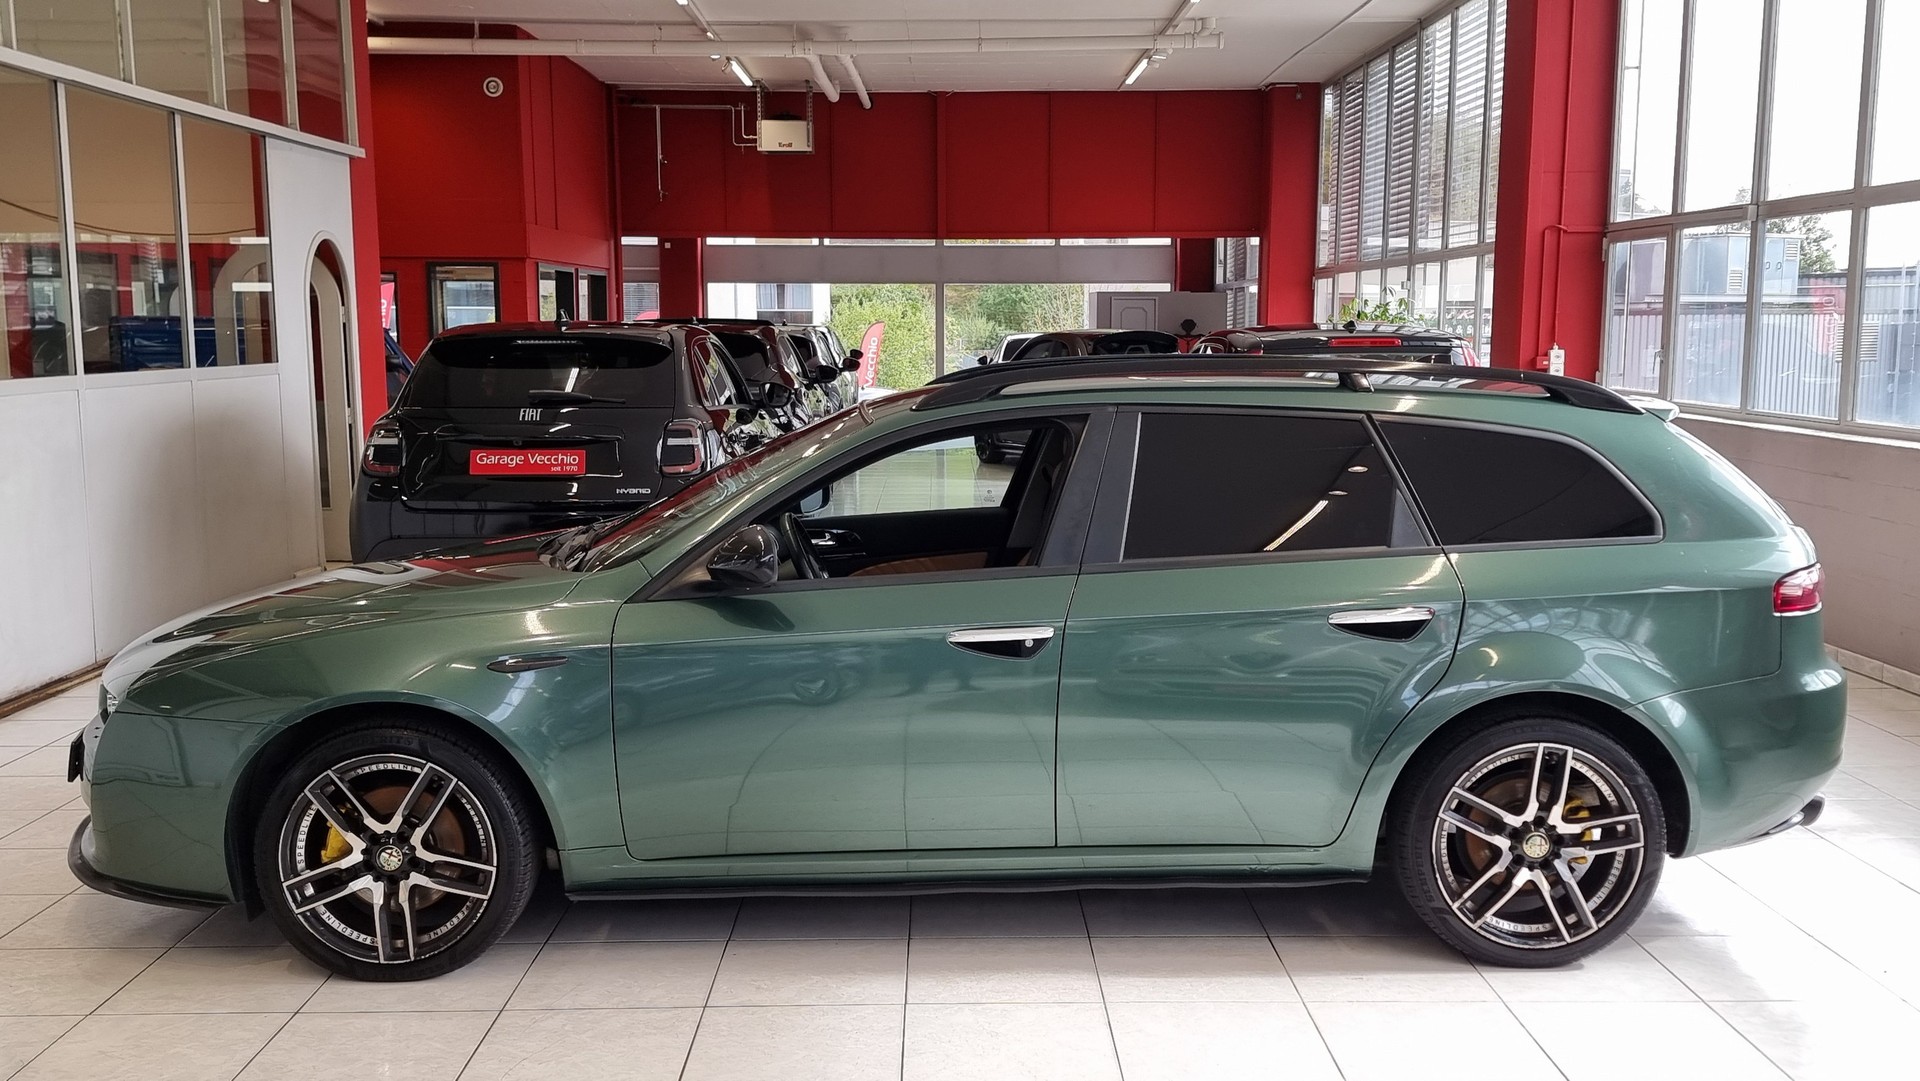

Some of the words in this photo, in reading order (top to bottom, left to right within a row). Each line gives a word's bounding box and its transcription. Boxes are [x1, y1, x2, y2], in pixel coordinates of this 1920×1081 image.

[864, 337, 878, 389] Vecchio
[519, 408, 543, 421] FIAT
[476, 453, 525, 467] Garage
[527, 453, 579, 465] Vecchio
[354, 763, 417, 775] SPEEDLINE
[1572, 761, 1617, 806] SPEEDLINE
[297, 805, 318, 865] SPEEDLINE
[1592, 852, 1624, 906] SPEEDLINE
[320, 909, 376, 945] SPEEDLINE
[426, 895, 476, 940] SPEEDLINE
[1489, 916, 1549, 932] SPEEDLINE
